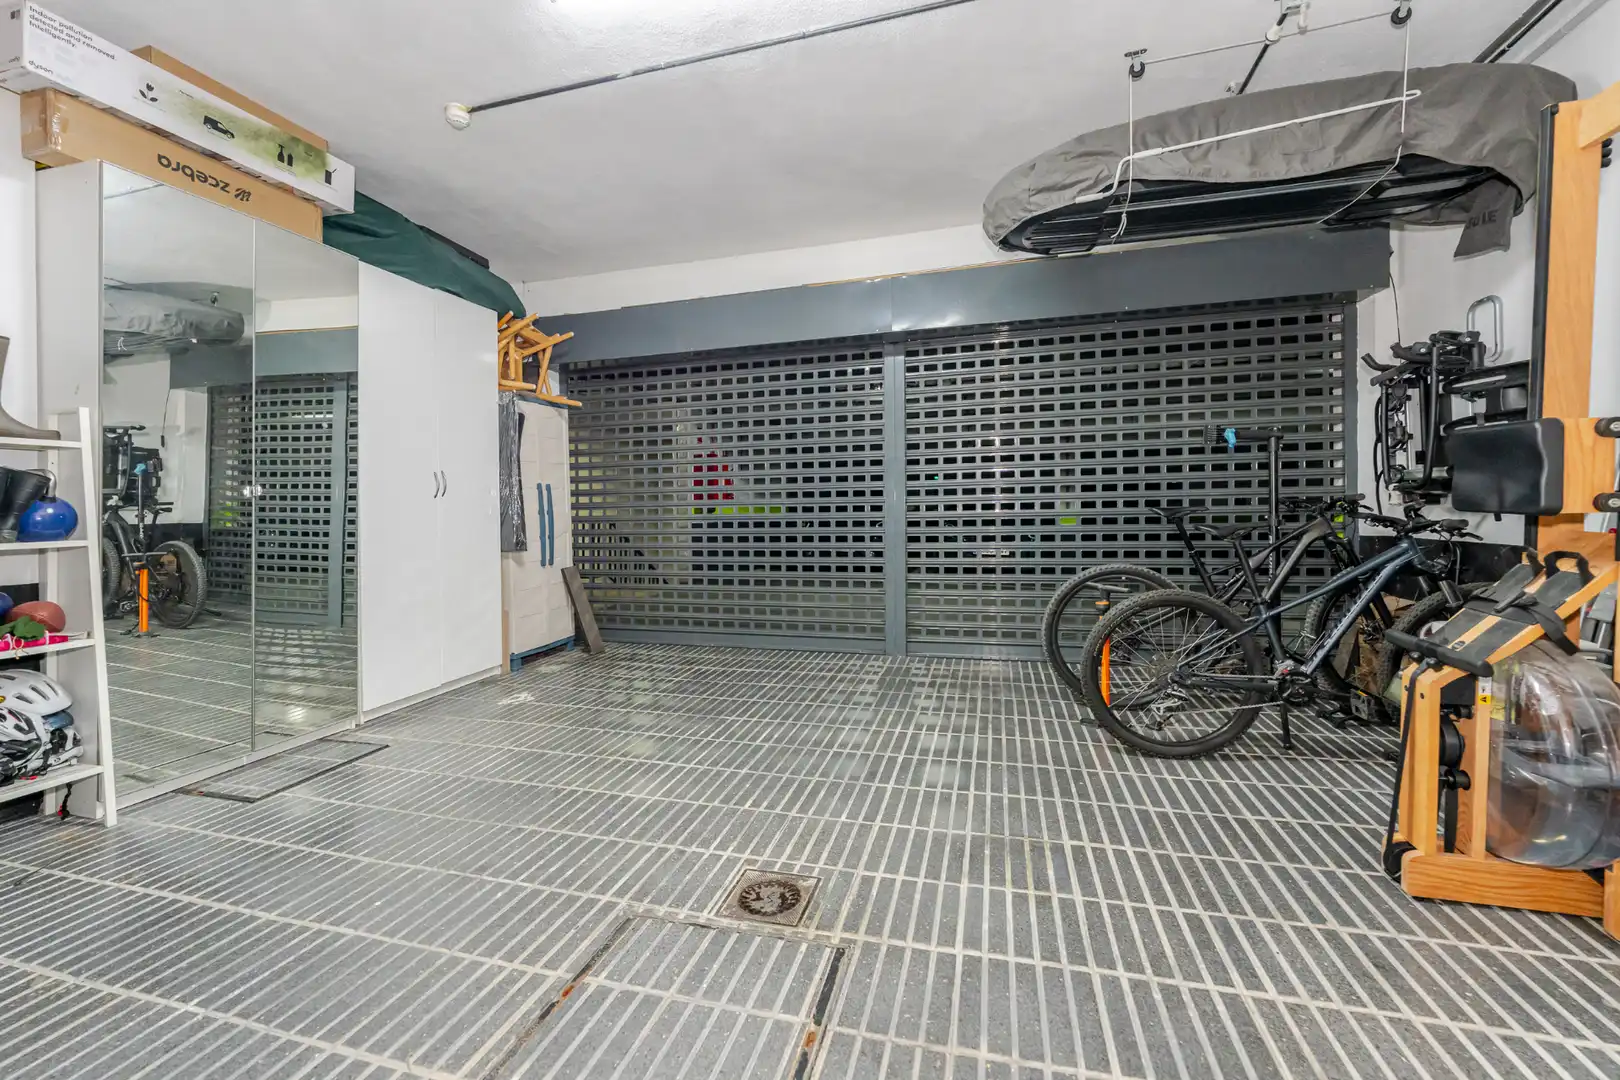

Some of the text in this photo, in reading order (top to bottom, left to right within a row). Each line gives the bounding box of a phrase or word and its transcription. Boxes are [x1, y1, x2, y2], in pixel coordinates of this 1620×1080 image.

[29, 5, 93, 42] Indoor pollution
[29, 13, 118, 61] detected and removed.
[28, 60, 54, 75] dyson
[157, 153, 231, 194] zcebra
